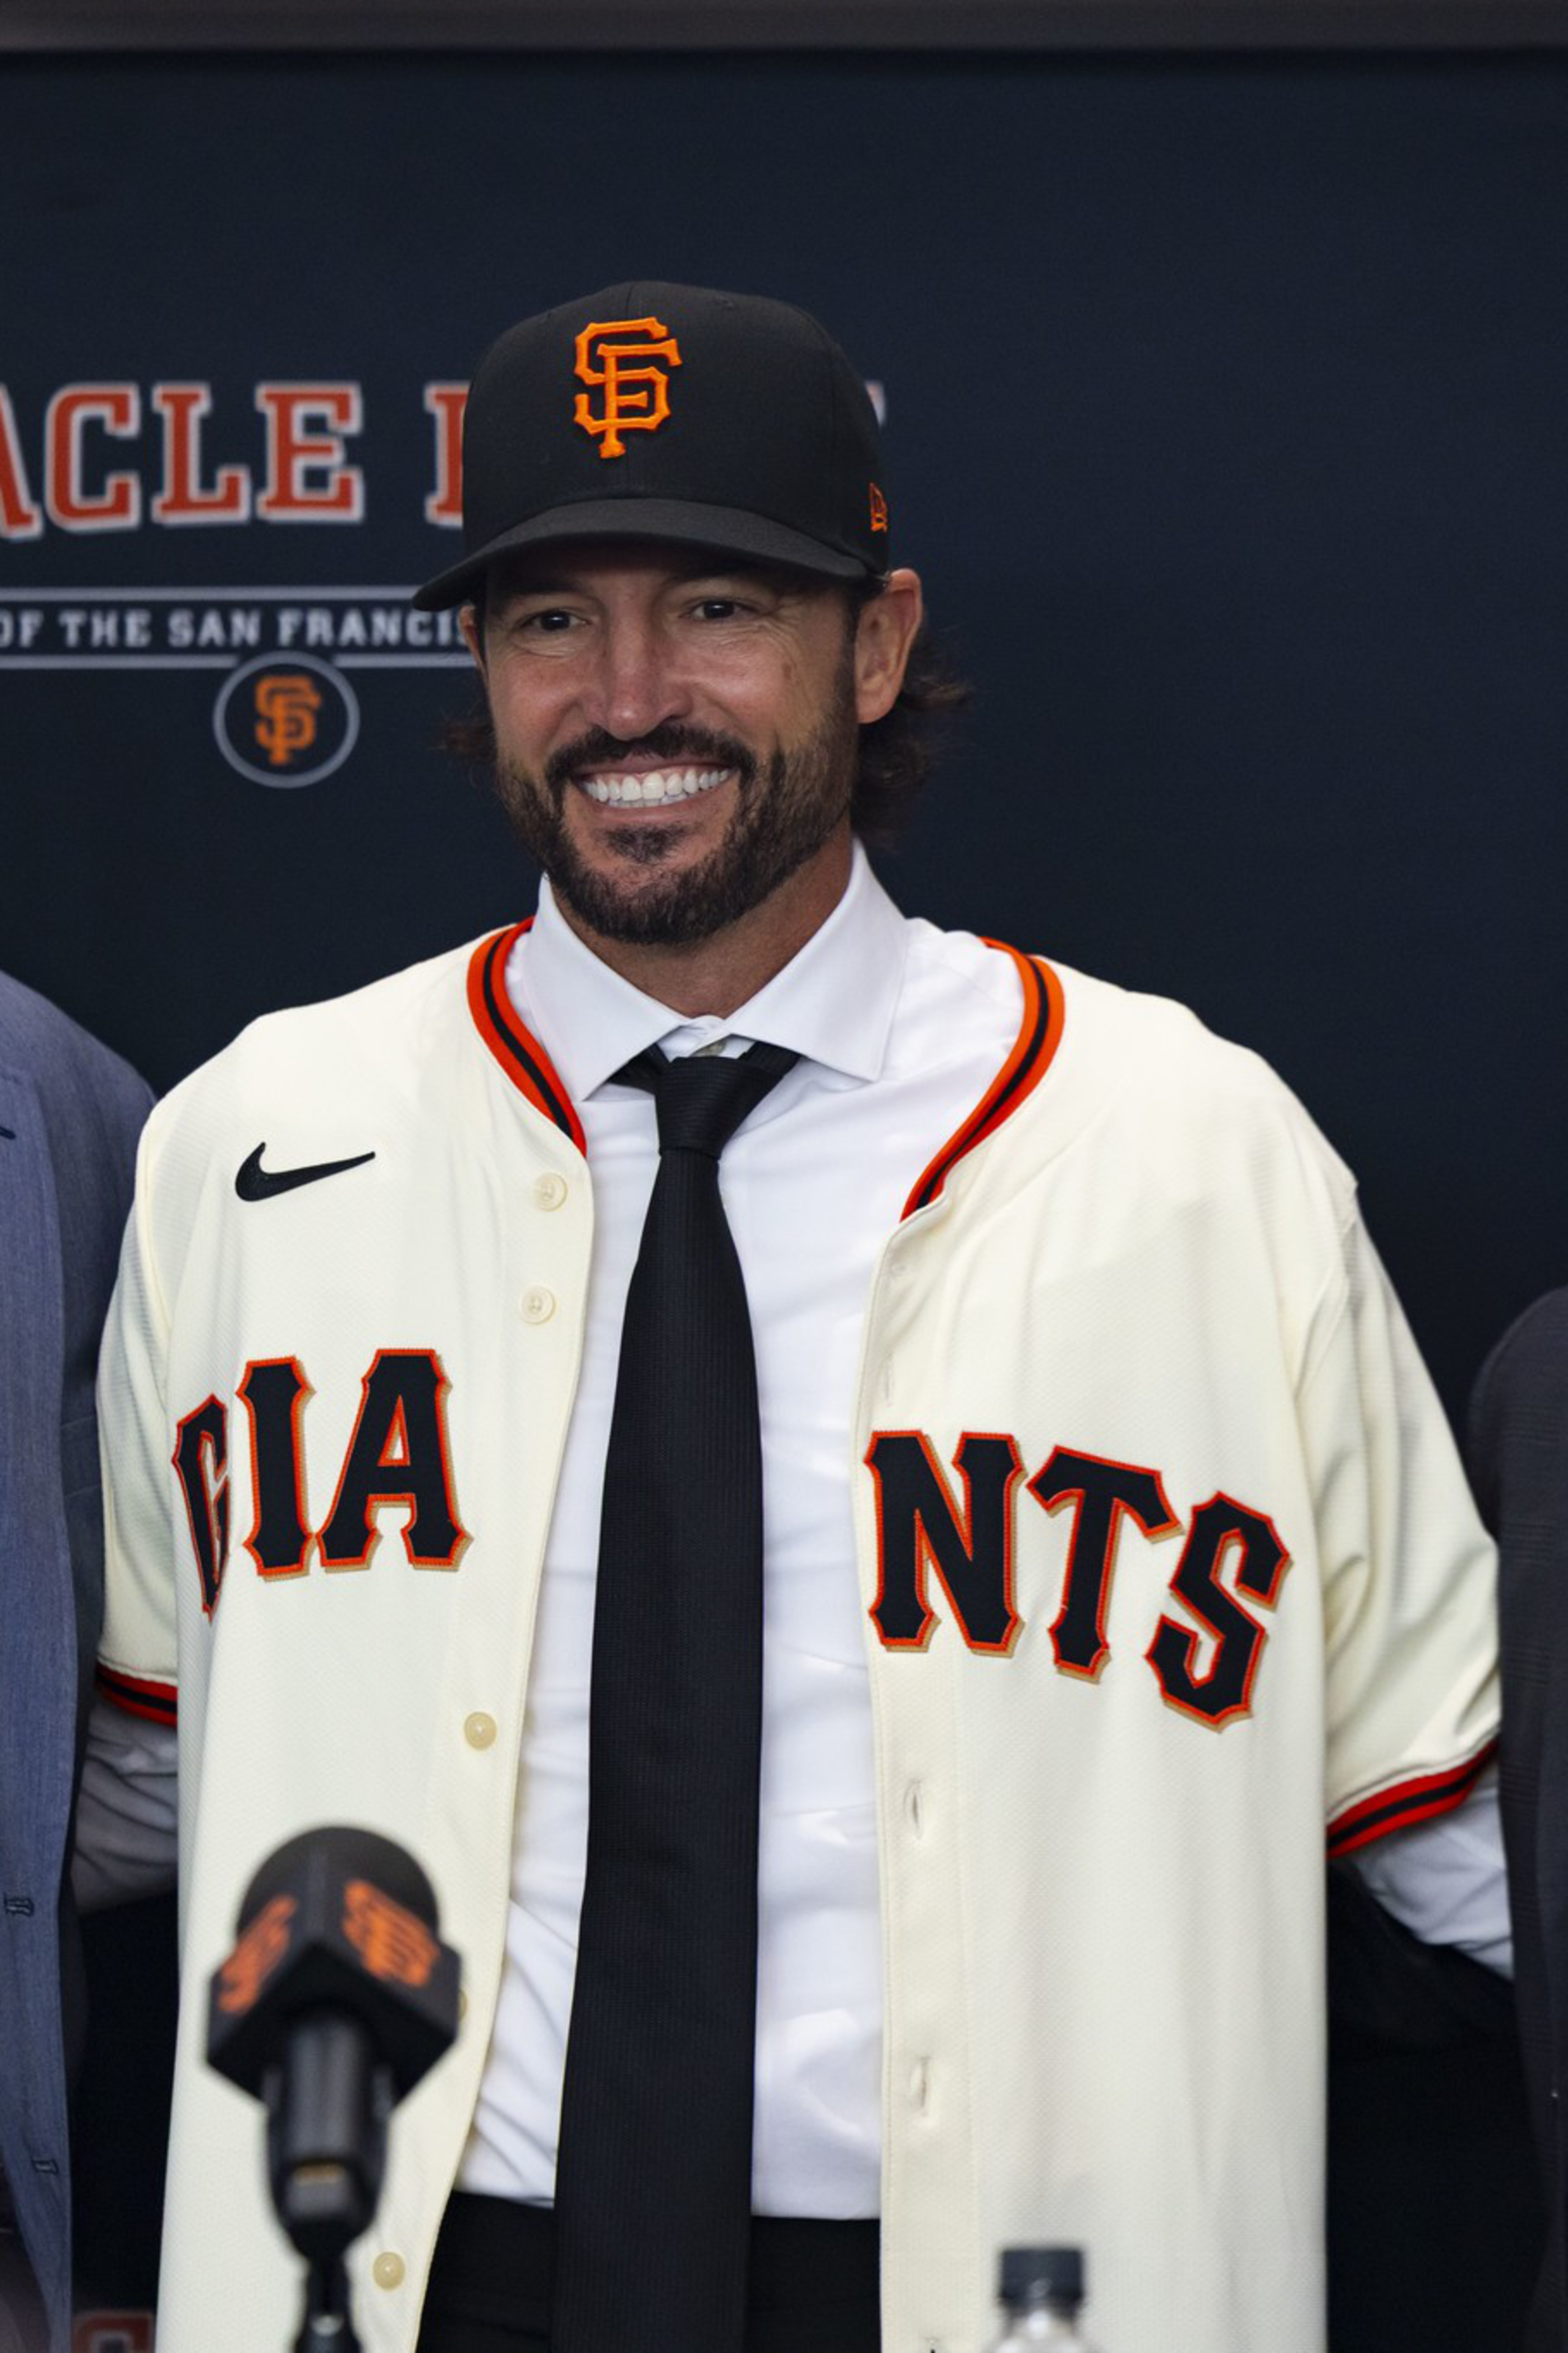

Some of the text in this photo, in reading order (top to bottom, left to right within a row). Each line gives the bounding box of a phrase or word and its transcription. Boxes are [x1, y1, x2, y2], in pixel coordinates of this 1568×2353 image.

[573, 316, 682, 459] SF
[59, 608, 151, 647] THE
[168, 608, 260, 647] SAN
